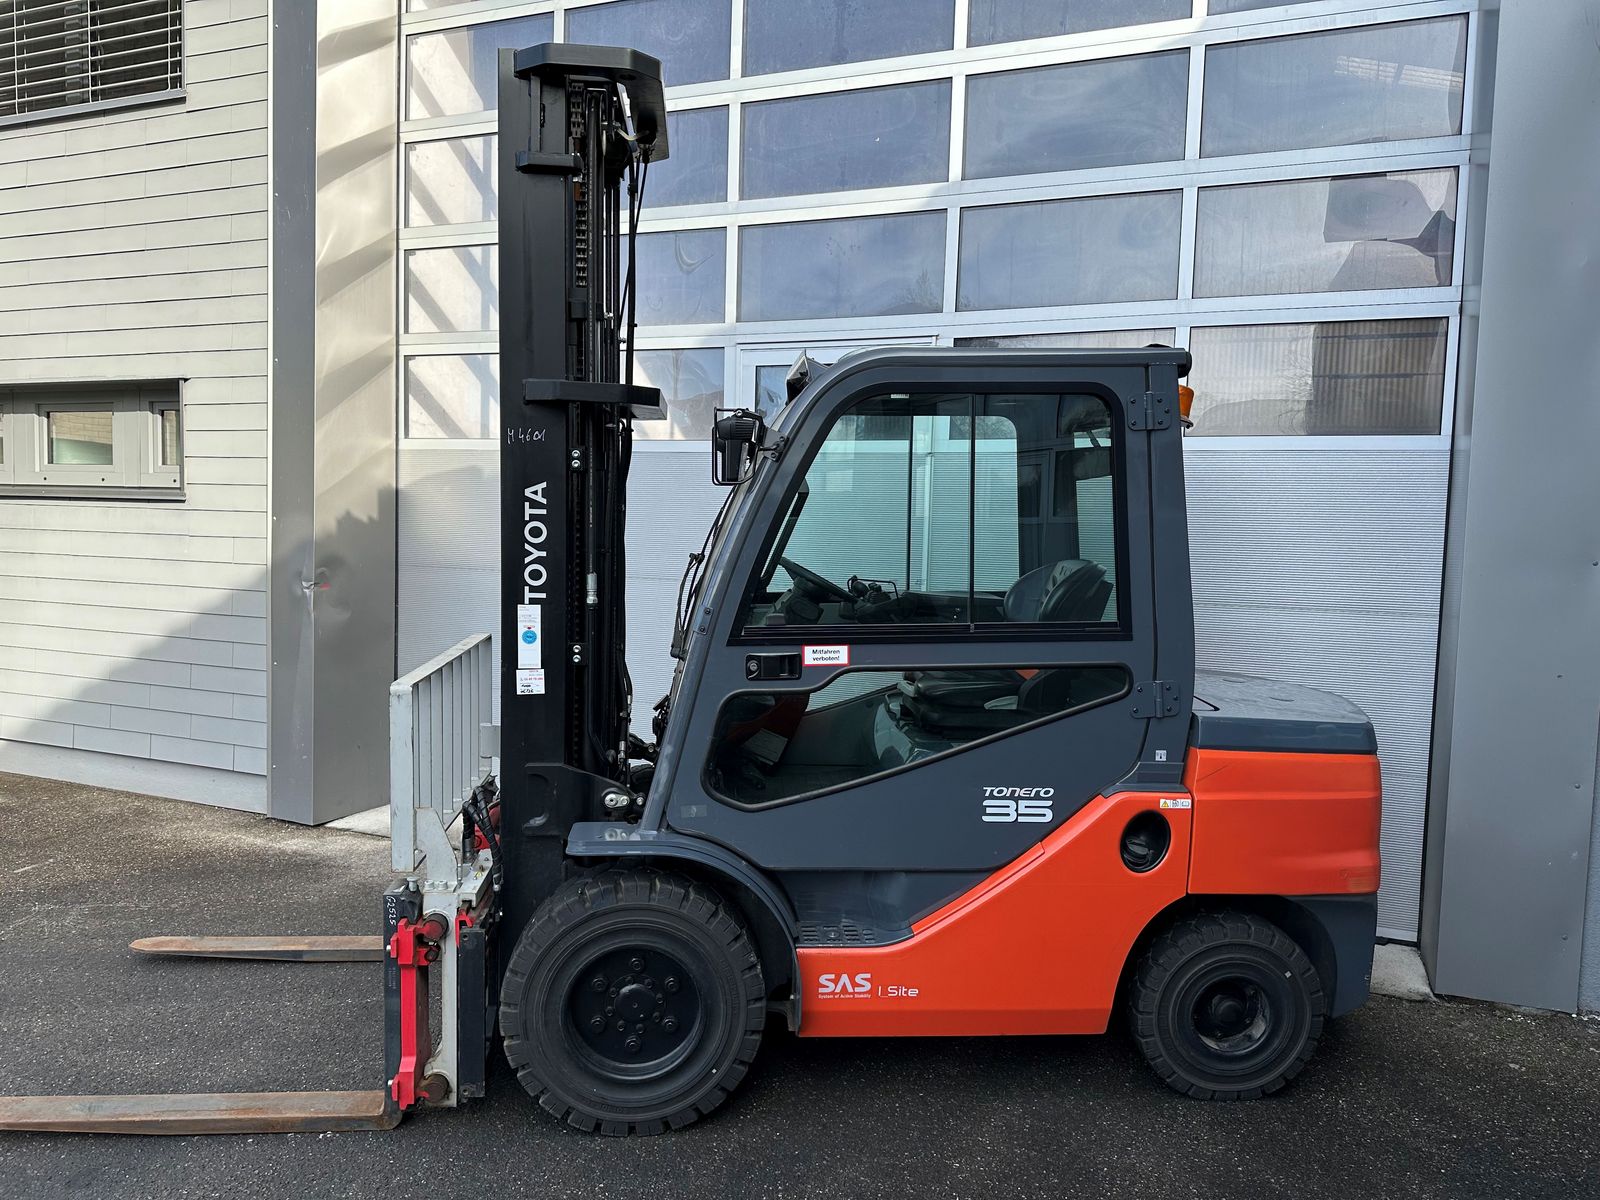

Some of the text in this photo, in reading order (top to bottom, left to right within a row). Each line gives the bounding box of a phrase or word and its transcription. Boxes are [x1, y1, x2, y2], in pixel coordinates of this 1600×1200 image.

[524, 481, 548, 604] TOYOTA
[981, 799, 1054, 823] 35
[818, 973, 872, 993] SAS
